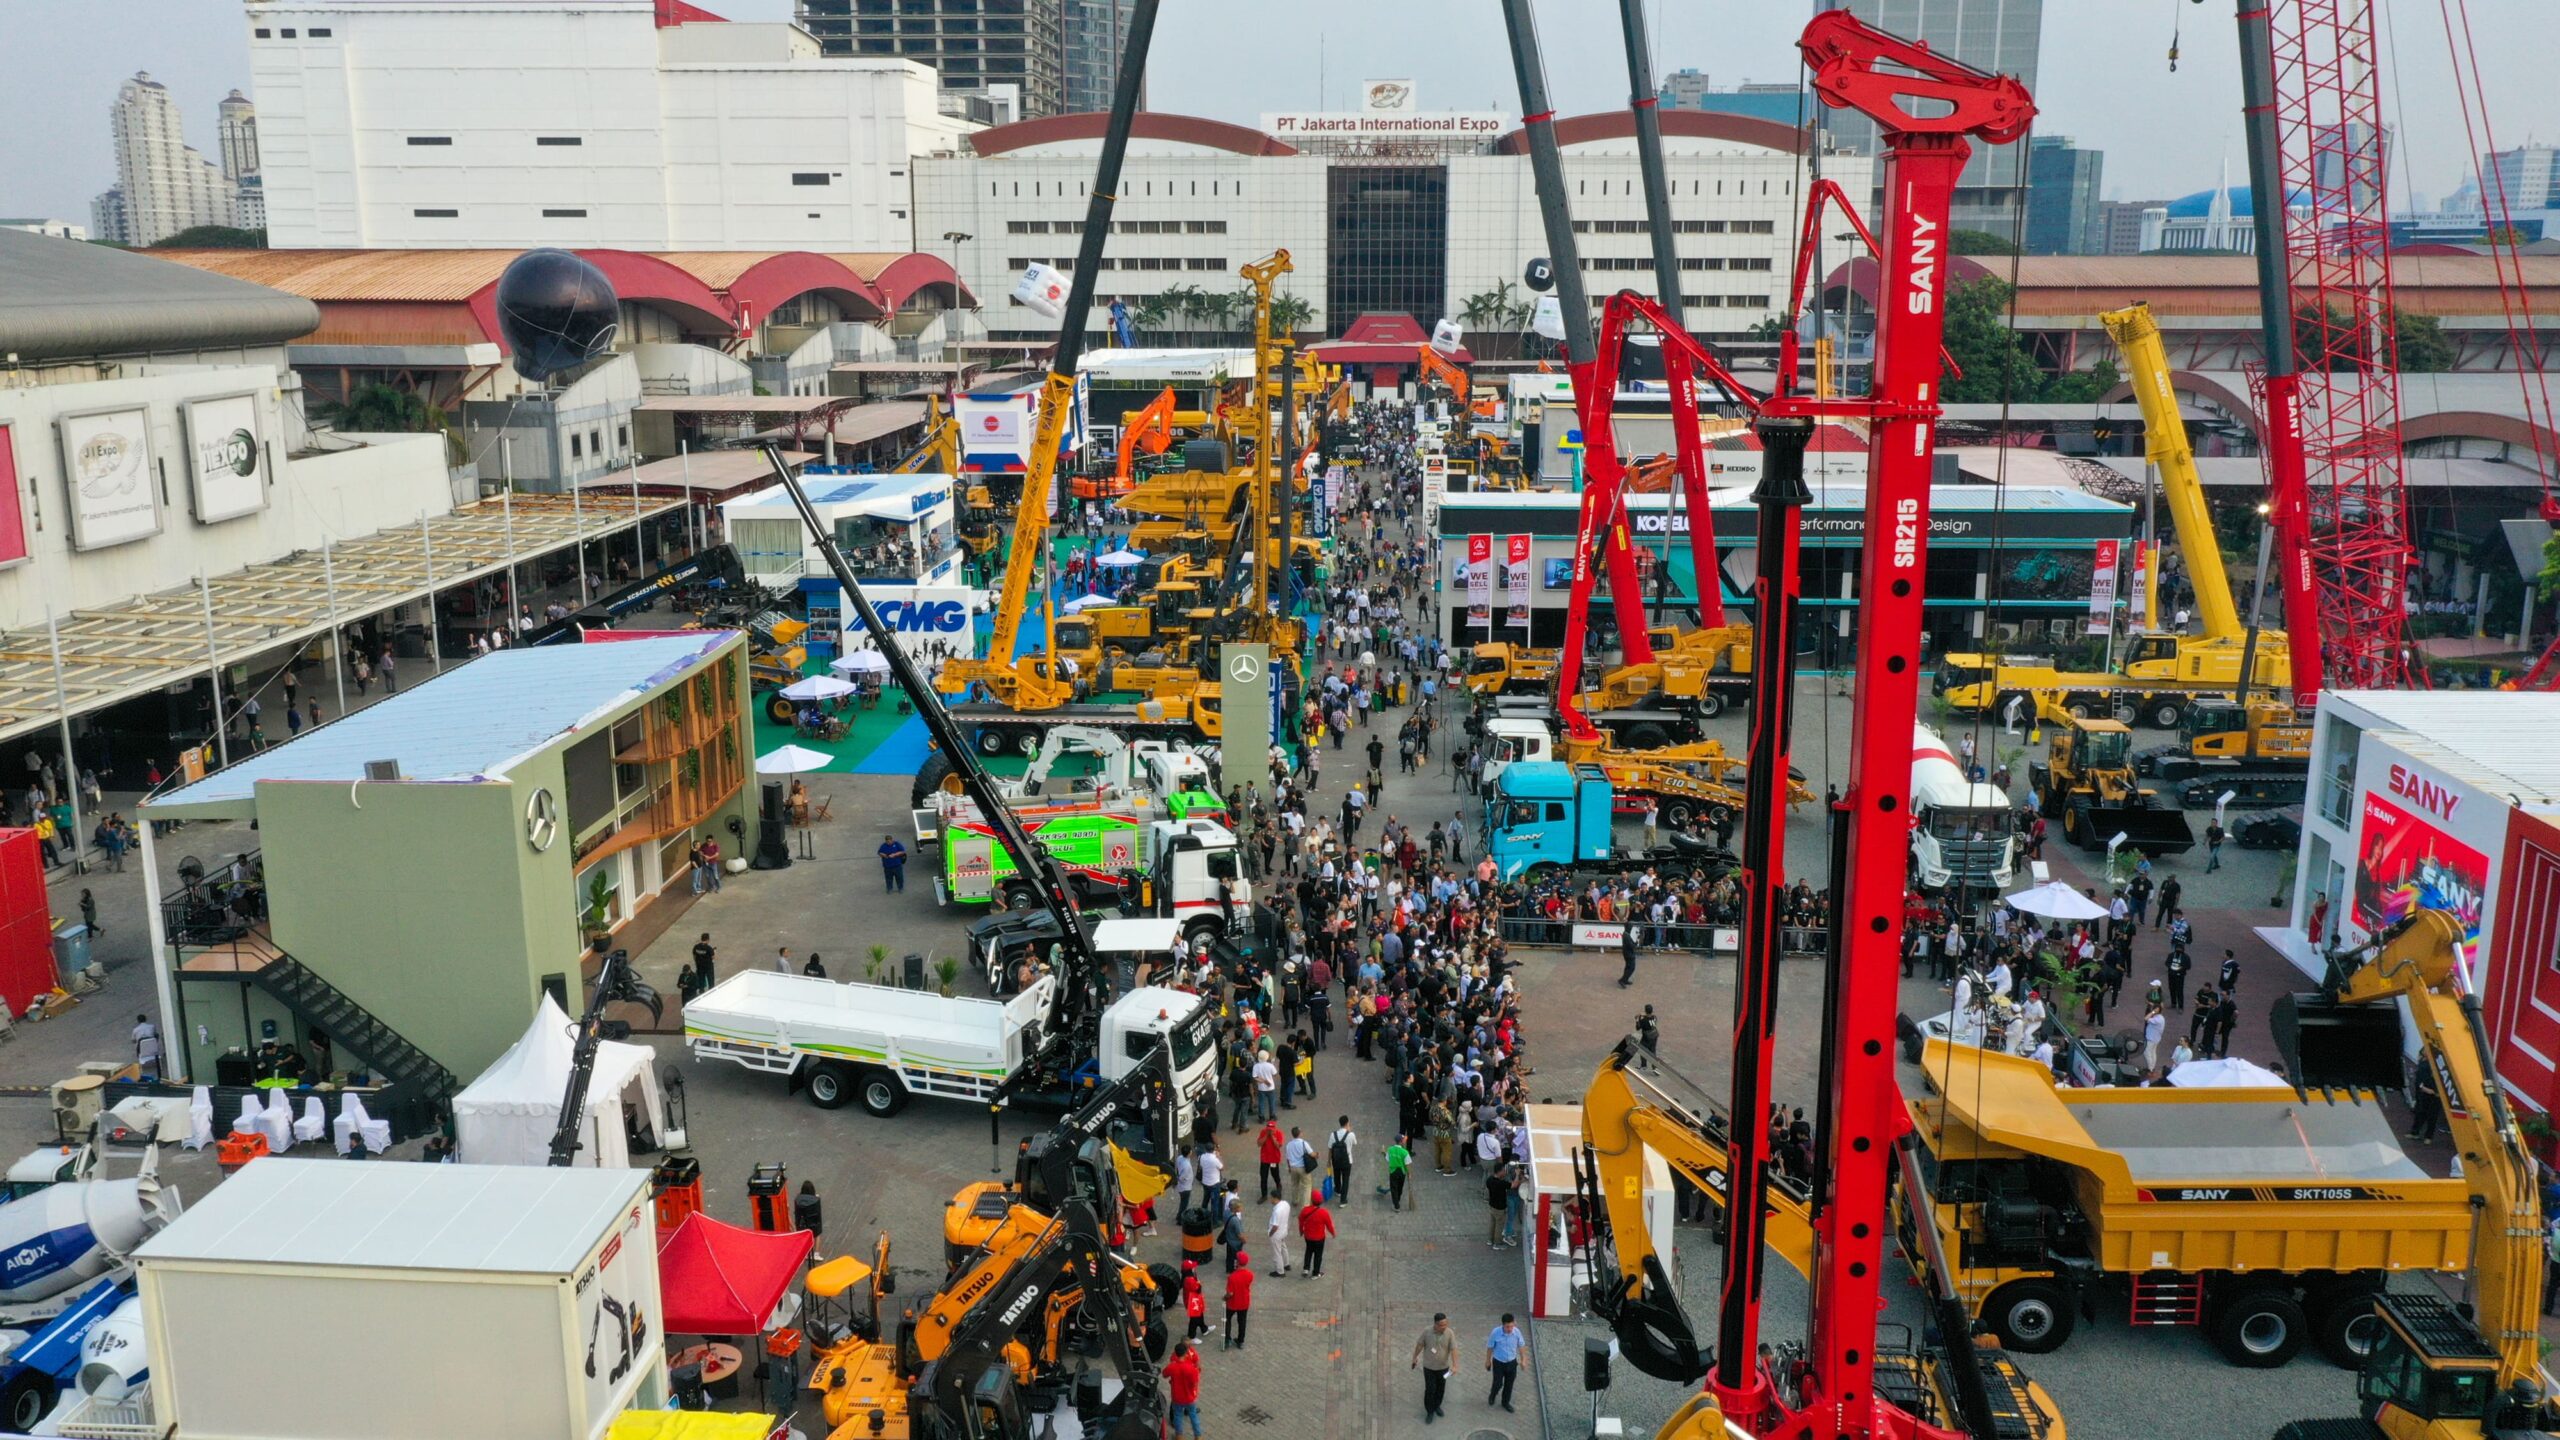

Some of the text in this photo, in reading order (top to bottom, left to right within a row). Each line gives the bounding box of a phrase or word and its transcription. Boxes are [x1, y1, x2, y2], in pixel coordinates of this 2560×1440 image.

[1278, 116, 1500, 133] PT Jakarta International Expo
[1908, 213, 1937, 315] SANY
[743, 309, 751, 331] A
[1681, 379, 1693, 408] SANY
[2287, 395, 2300, 438] SANY
[909, 452, 928, 471] XCMG
[1726, 465, 1757, 473] HEXINDO
[1636, 514, 1690, 532] KOBEL
[1893, 497, 1919, 568] SR215
[1470, 571, 1488, 580] WE
[1510, 572, 1527, 581] WE
[1576, 551, 1587, 582] SANY
[2093, 579, 2112, 588] WE
[2134, 579, 2145, 588] W
[845, 600, 967, 633] XCMG
[2279, 729, 2309, 737] SANY
[2388, 763, 2460, 822] SANY
[2373, 807, 2397, 827] SANY
[1034, 832, 1068, 841] ERKASA
[1047, 844, 1075, 852] ESCUE
[2421, 865, 2483, 917] SANY
[1597, 931, 1625, 940] SANY
[1192, 1024, 1206, 1047] 6X4
[2435, 1053, 2461, 1107] SANY
[1082, 1101, 1117, 1134] TATSUO
[1705, 1170, 1727, 1192] SA
[2181, 1188, 2353, 1201] SANY SKT105S
[6, 1244, 50, 1272] AIMIX
[956, 1271, 995, 1306] TATSUO
[999, 1284, 1040, 1327] TATSUO
